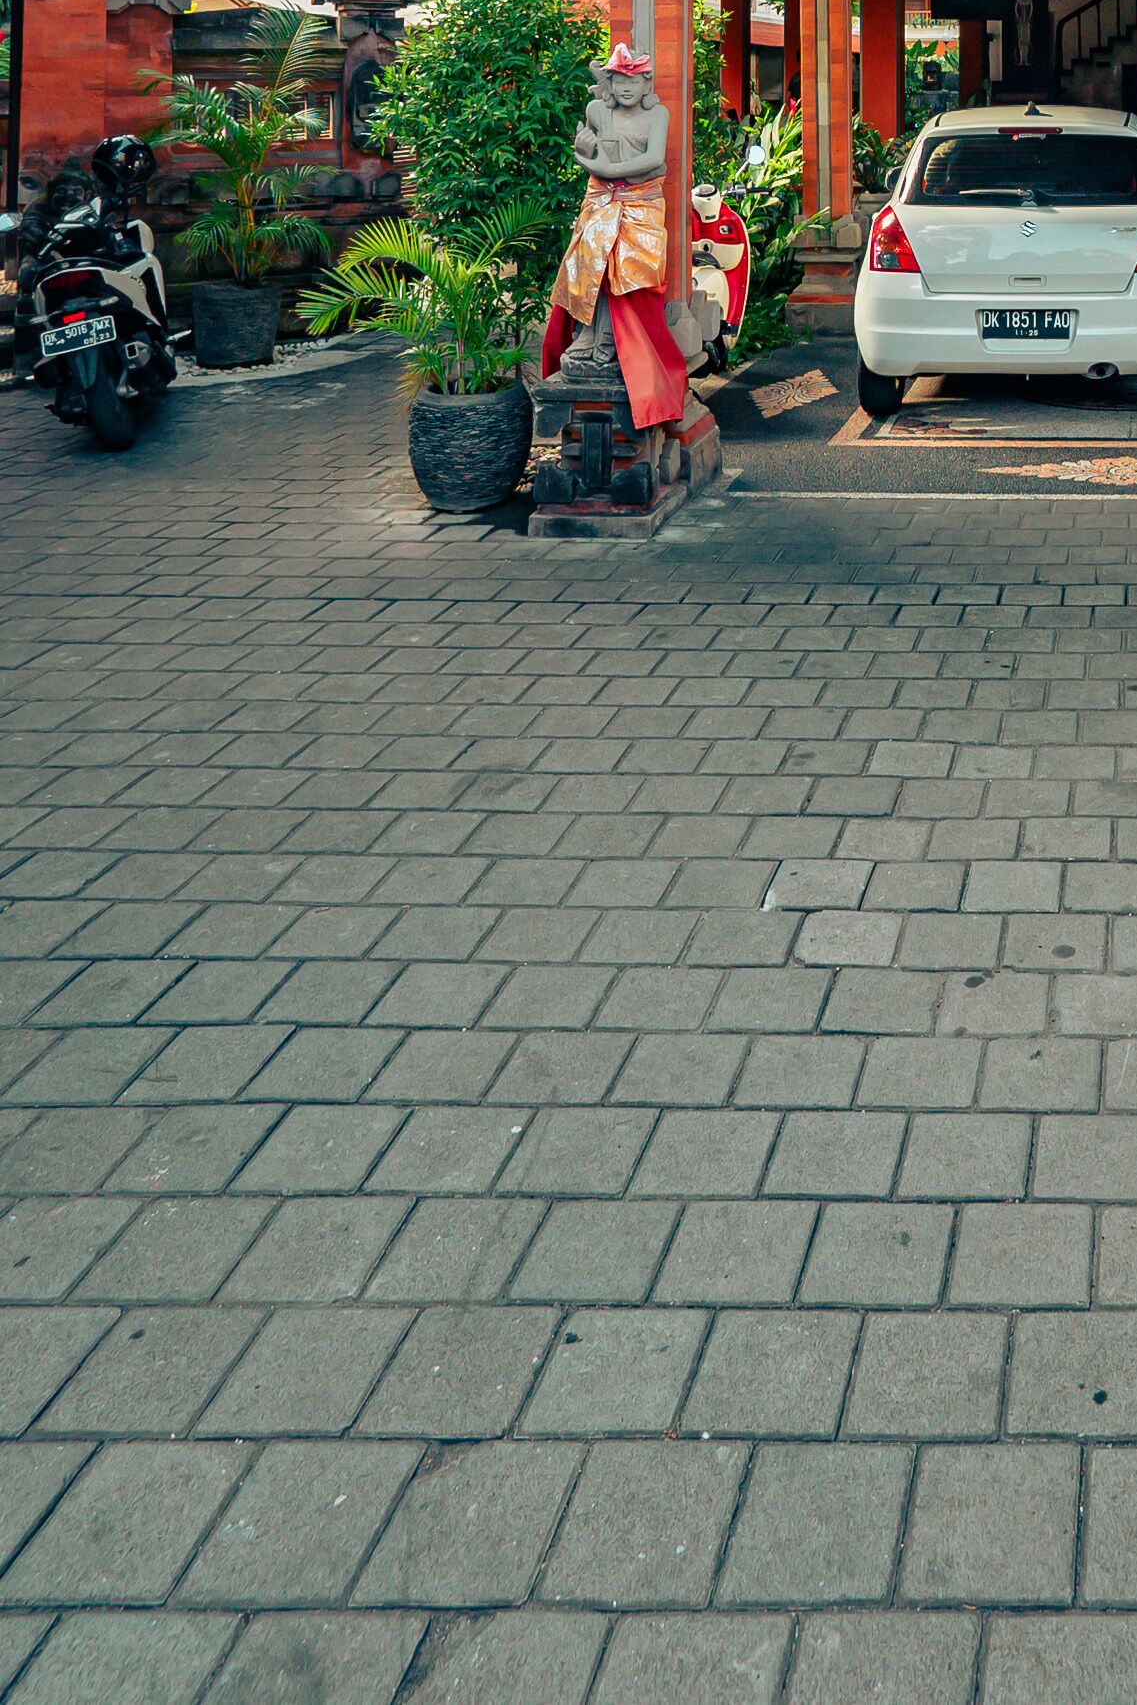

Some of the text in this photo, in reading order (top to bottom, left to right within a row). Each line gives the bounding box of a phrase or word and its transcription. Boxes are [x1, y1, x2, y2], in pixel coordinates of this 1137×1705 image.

[983, 311, 1000, 328] DK
[1005, 311, 1037, 328] 1851
[65, 324, 88, 339] 5016
